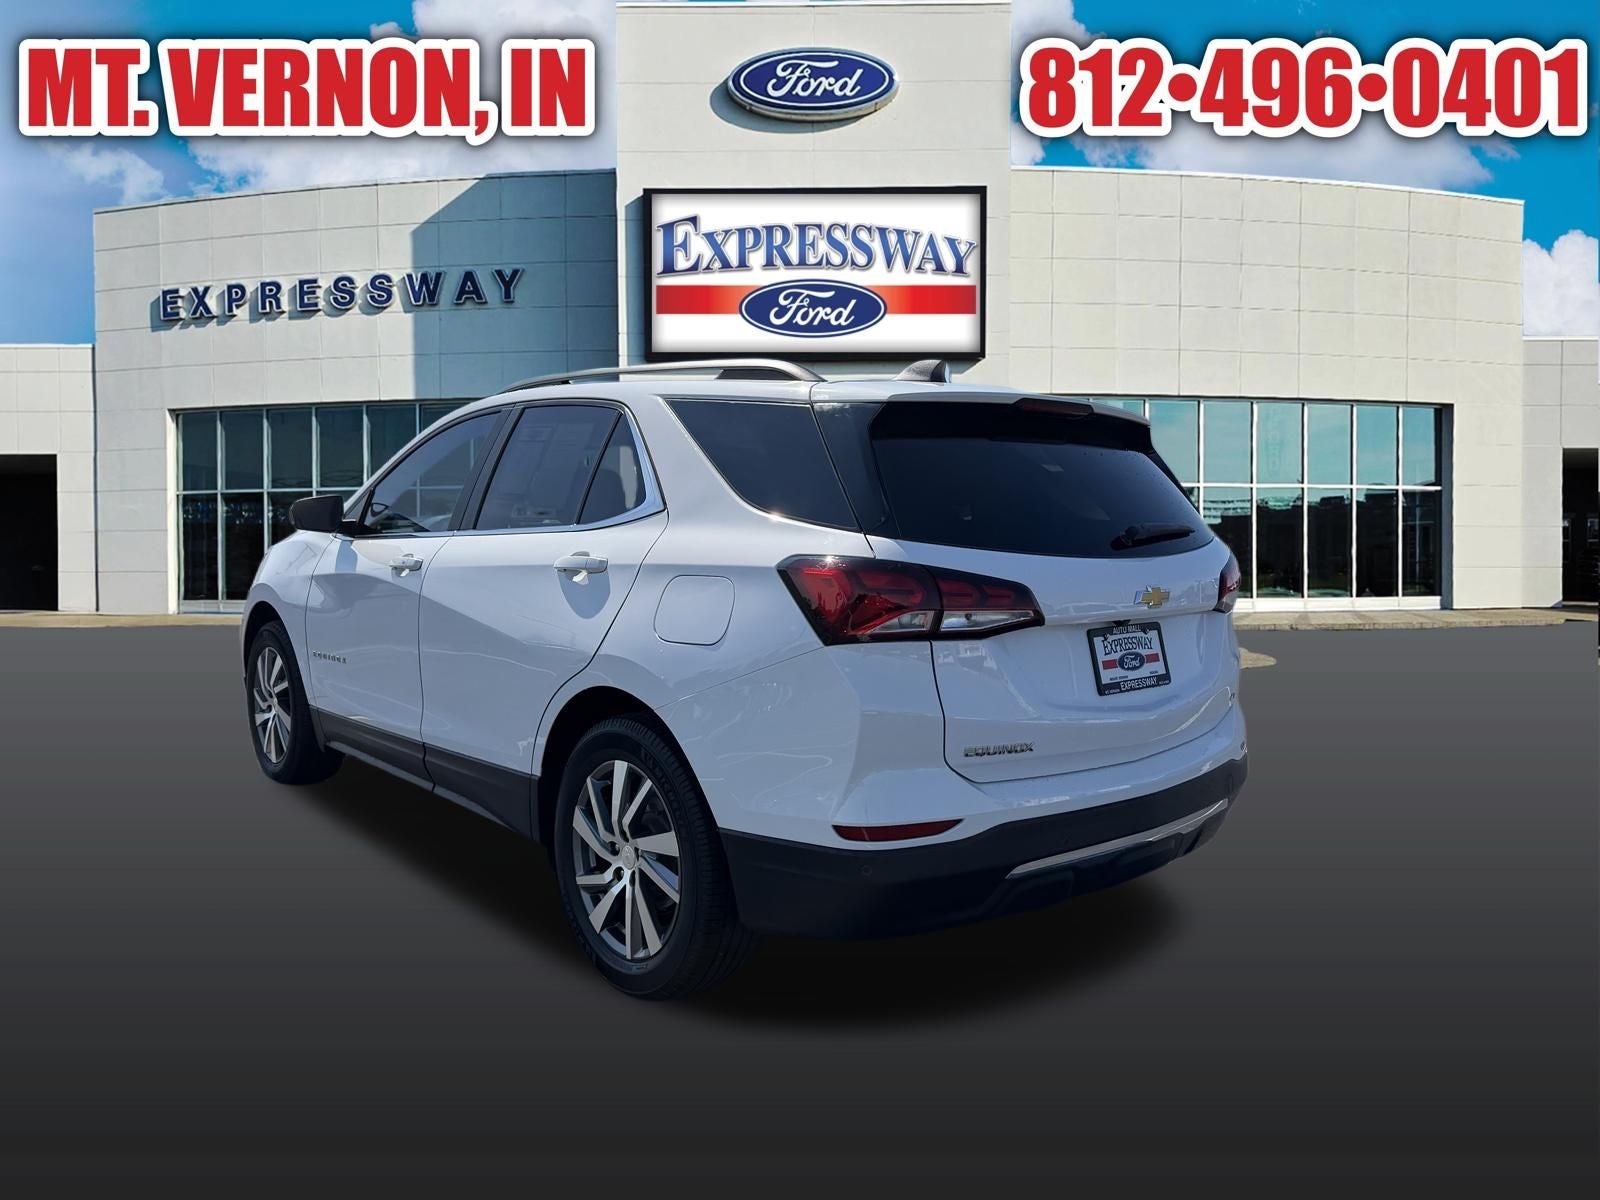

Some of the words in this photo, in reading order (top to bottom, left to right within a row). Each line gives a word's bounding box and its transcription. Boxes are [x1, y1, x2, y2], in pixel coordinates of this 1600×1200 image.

[766, 59, 861, 98] Ford
[655, 214, 978, 278] EXPRESSWAY
[159, 266, 525, 321] EXPRESSWAY
[768, 289, 855, 327] Ford
[1102, 636, 1153, 656] EXPRESSWAY
[1123, 655, 1141, 669] Ford
[1120, 677, 1158, 691] EXPRESSWAY
[963, 742, 1034, 758] EQUINOX
